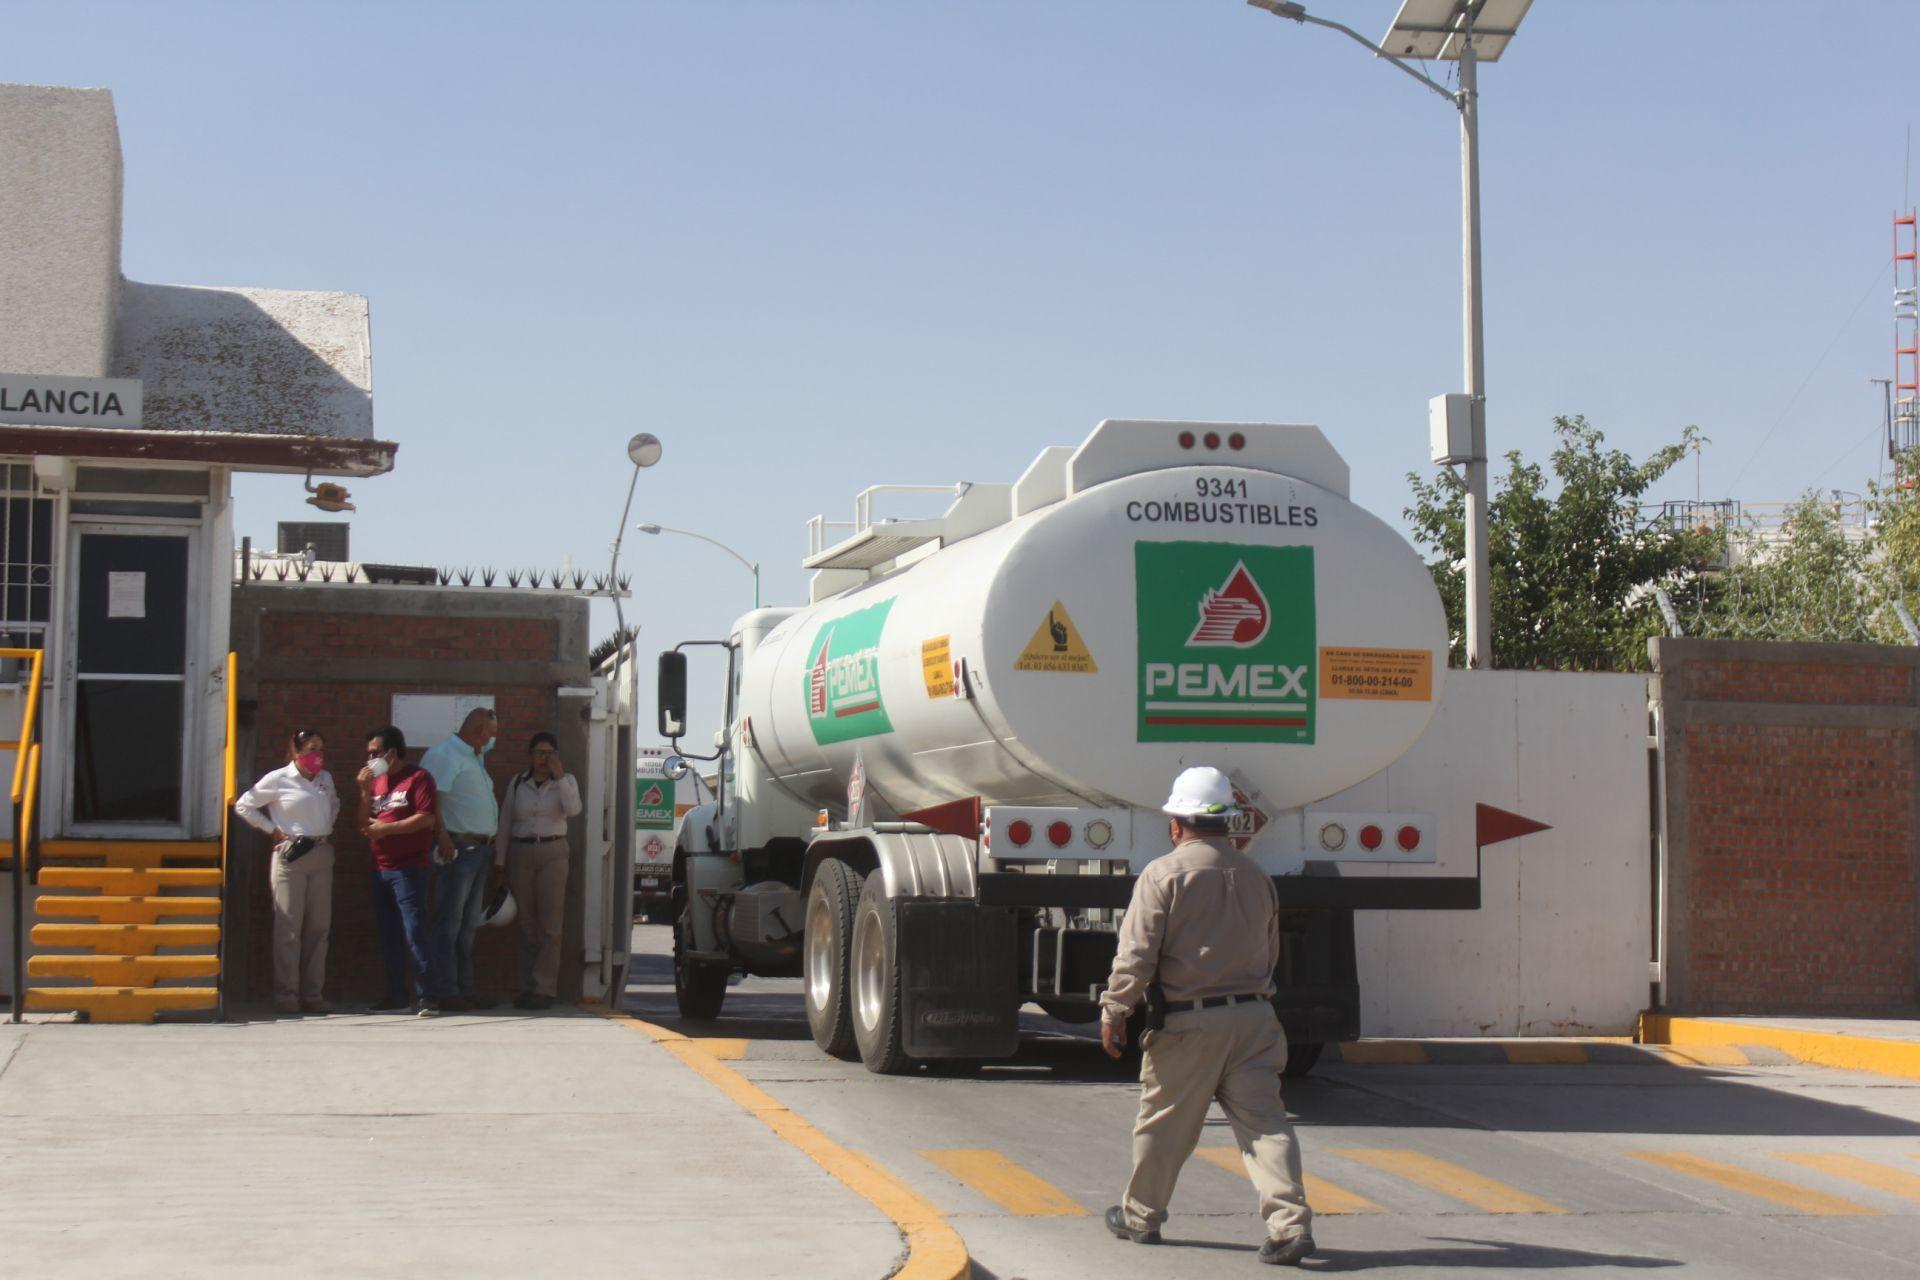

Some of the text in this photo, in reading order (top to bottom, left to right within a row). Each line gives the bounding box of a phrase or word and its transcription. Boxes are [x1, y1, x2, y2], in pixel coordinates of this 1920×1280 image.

[1, 387, 124, 416] LANCIA
[1196, 477, 1248, 498] 9341
[1126, 501, 1318, 527] COMBUSTIBLES
[1146, 662, 1307, 697] PEMEX
[636, 809, 672, 818] EMEX
